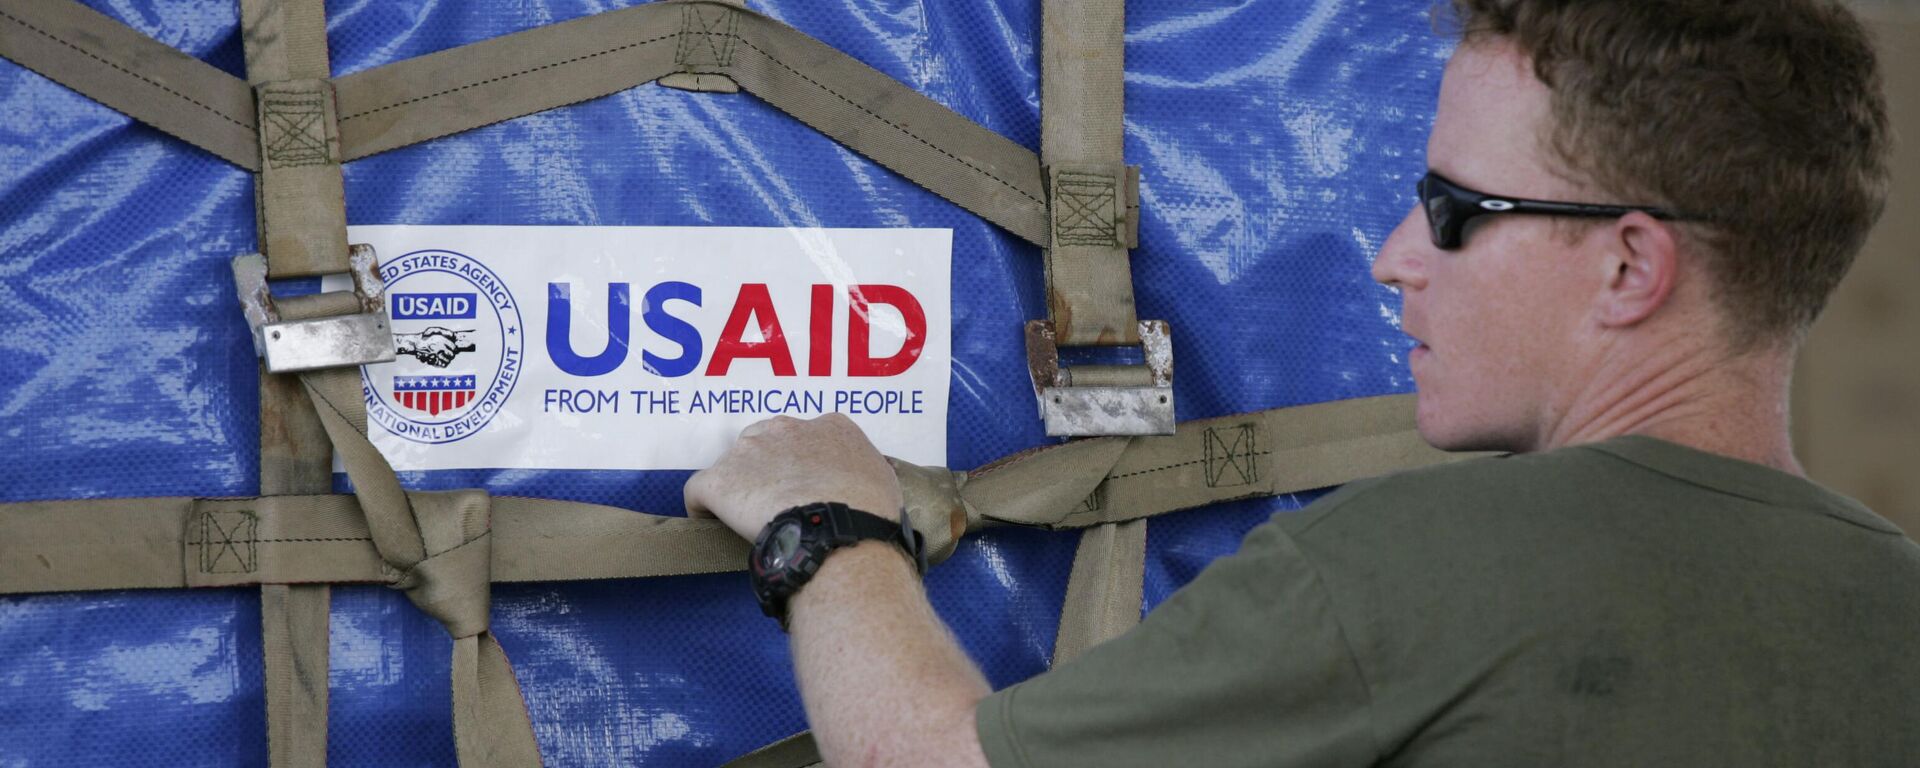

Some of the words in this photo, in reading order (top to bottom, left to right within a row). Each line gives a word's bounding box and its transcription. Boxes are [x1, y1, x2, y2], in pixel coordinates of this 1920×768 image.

[399, 297, 469, 315] USAID
[403, 255, 457, 272] STATES
[460, 264, 511, 311] AGENCY
[546, 281, 927, 377] USAID
[361, 377, 440, 439] RNATIONAL
[445, 347, 518, 439] DEVELOPMENT
[544, 390, 619, 413] FROM
[631, 390, 679, 414] THE
[689, 391, 823, 414] AMERICAN
[835, 391, 923, 414] PEOPLE
